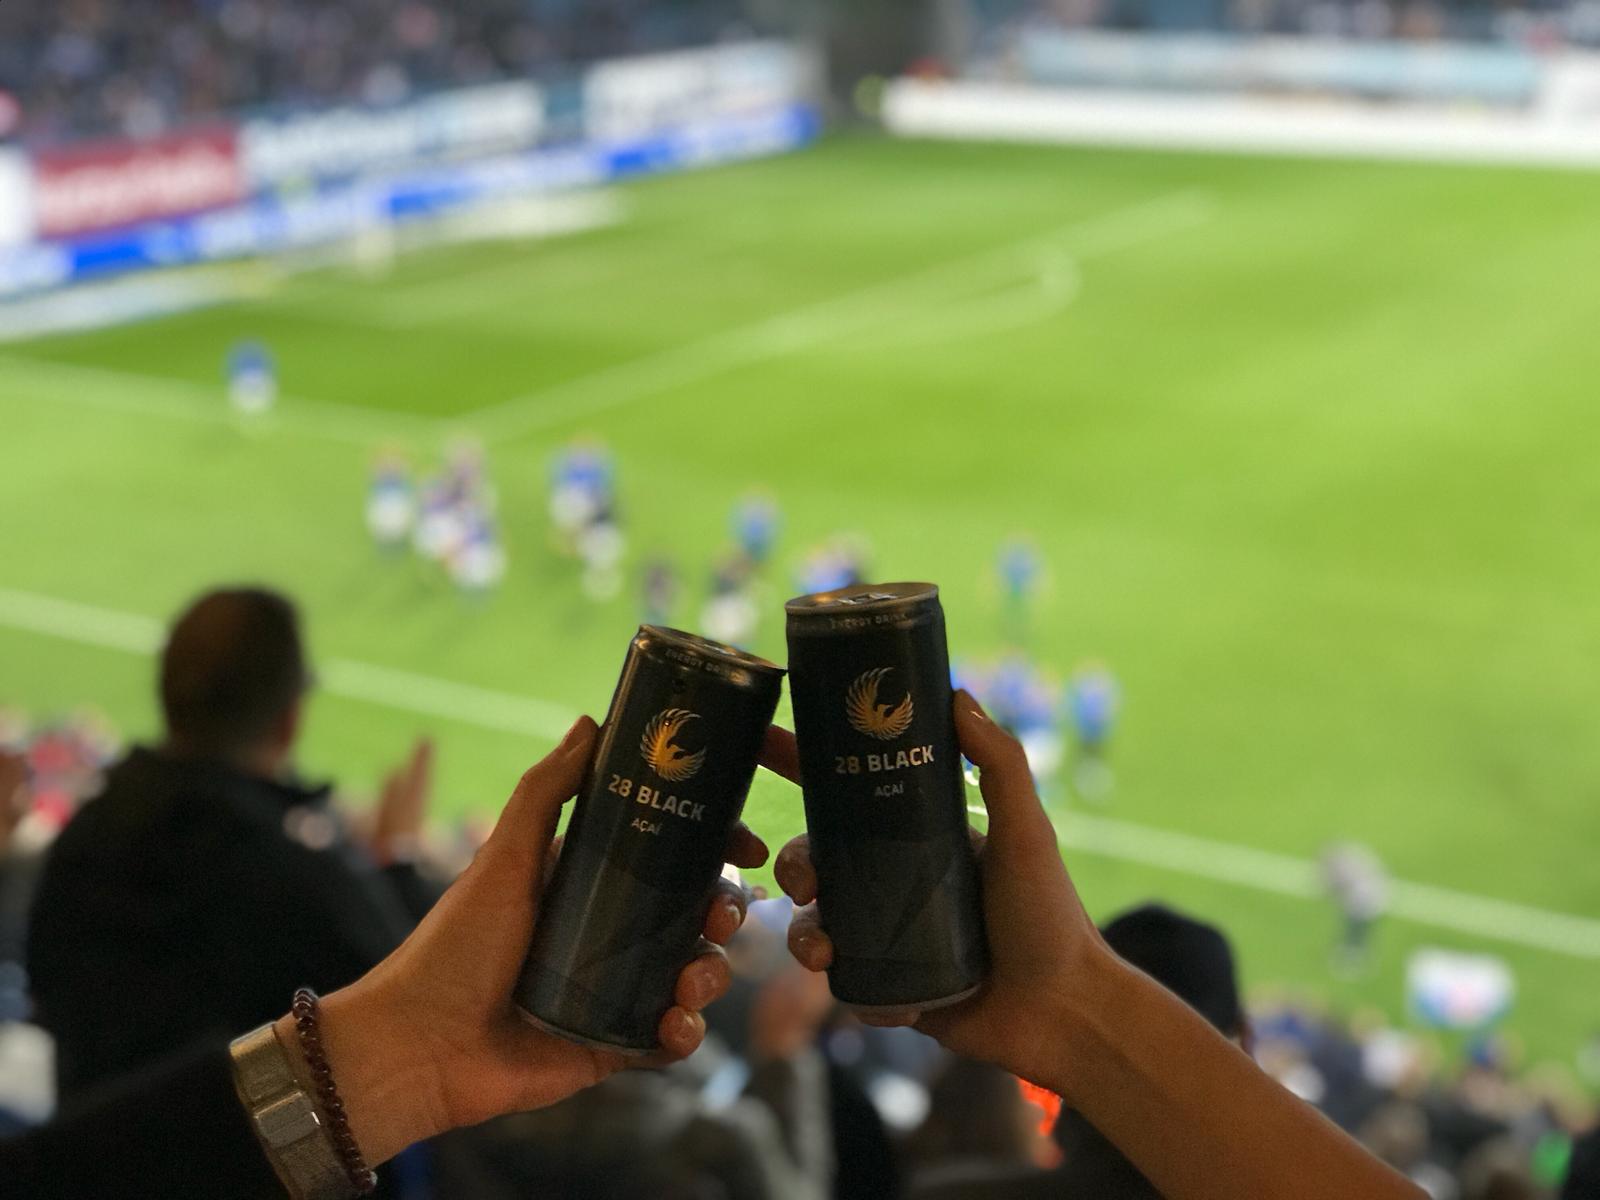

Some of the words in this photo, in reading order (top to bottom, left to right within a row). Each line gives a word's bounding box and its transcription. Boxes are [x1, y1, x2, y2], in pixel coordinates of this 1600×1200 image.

[834, 755, 860, 776] 28
[867, 744, 935, 773] BLACK
[608, 774, 632, 798] 28
[636, 784, 707, 822] BLACK
